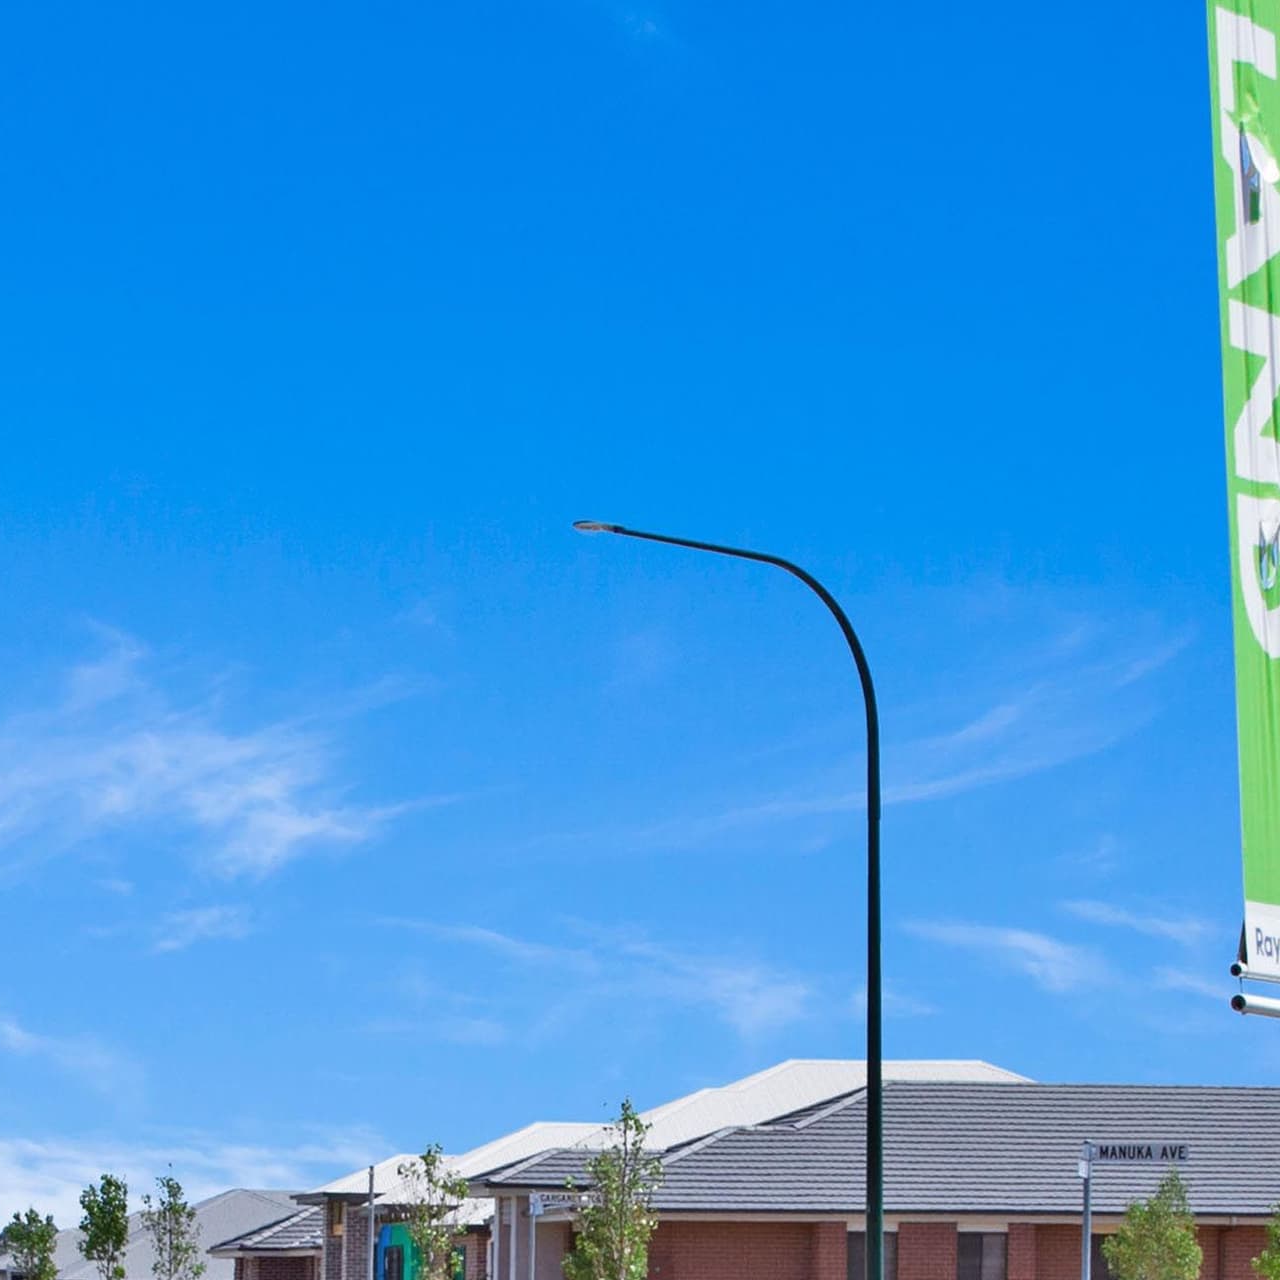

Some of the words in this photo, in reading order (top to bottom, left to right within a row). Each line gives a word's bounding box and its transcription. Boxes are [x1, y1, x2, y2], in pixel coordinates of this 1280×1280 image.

[1255, 927, 1280, 965] Ray
[1099, 1145, 1153, 1160] MANUKA
[1160, 1145, 1187, 1160] AVE
